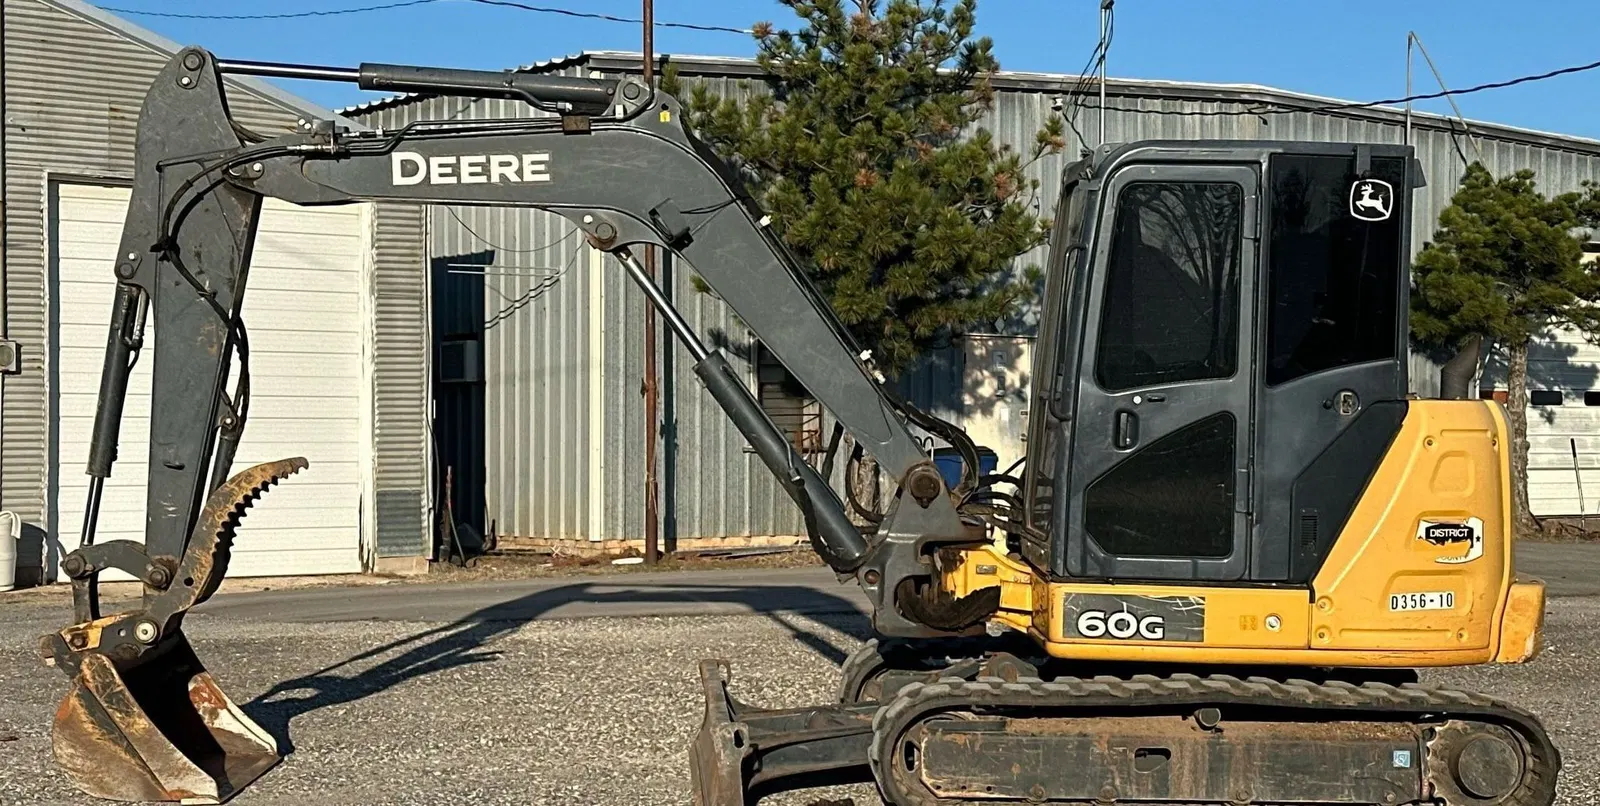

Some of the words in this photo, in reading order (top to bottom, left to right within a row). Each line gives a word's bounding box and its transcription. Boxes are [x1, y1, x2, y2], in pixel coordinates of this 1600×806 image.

[391, 151, 551, 186] DEERE
[1429, 528, 1470, 538] DISTRICT
[1077, 609, 1165, 640] 60G
